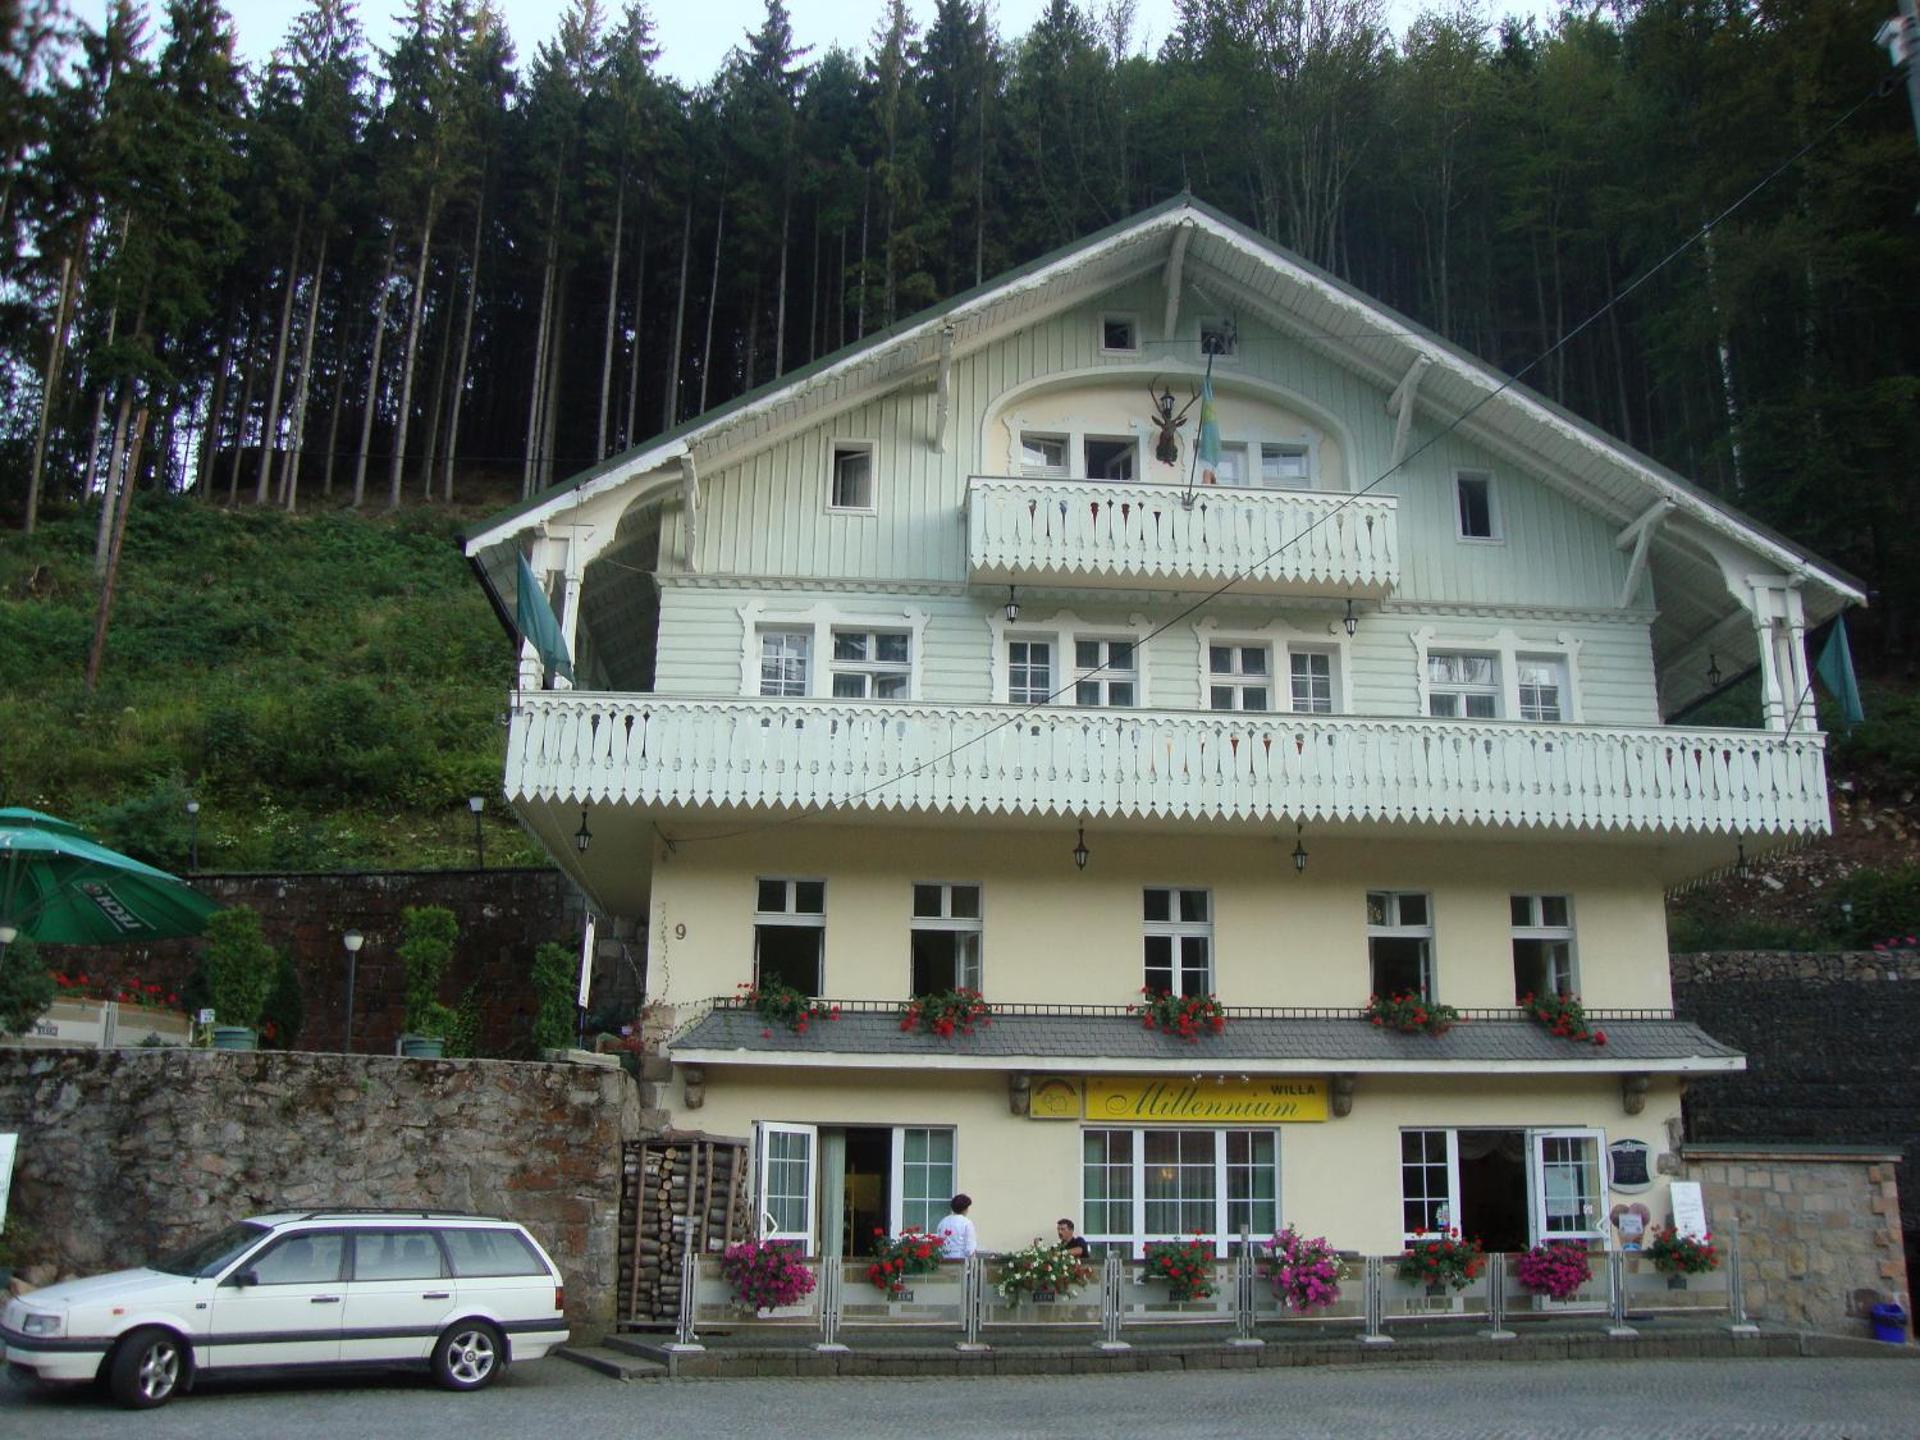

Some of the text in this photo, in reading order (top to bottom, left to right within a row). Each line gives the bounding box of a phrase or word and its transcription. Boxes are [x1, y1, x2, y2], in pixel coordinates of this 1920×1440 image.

[675, 923, 687, 940] 9
[1270, 1084, 1316, 1096] WILLA
[1105, 1081, 1298, 1117] Millennium
